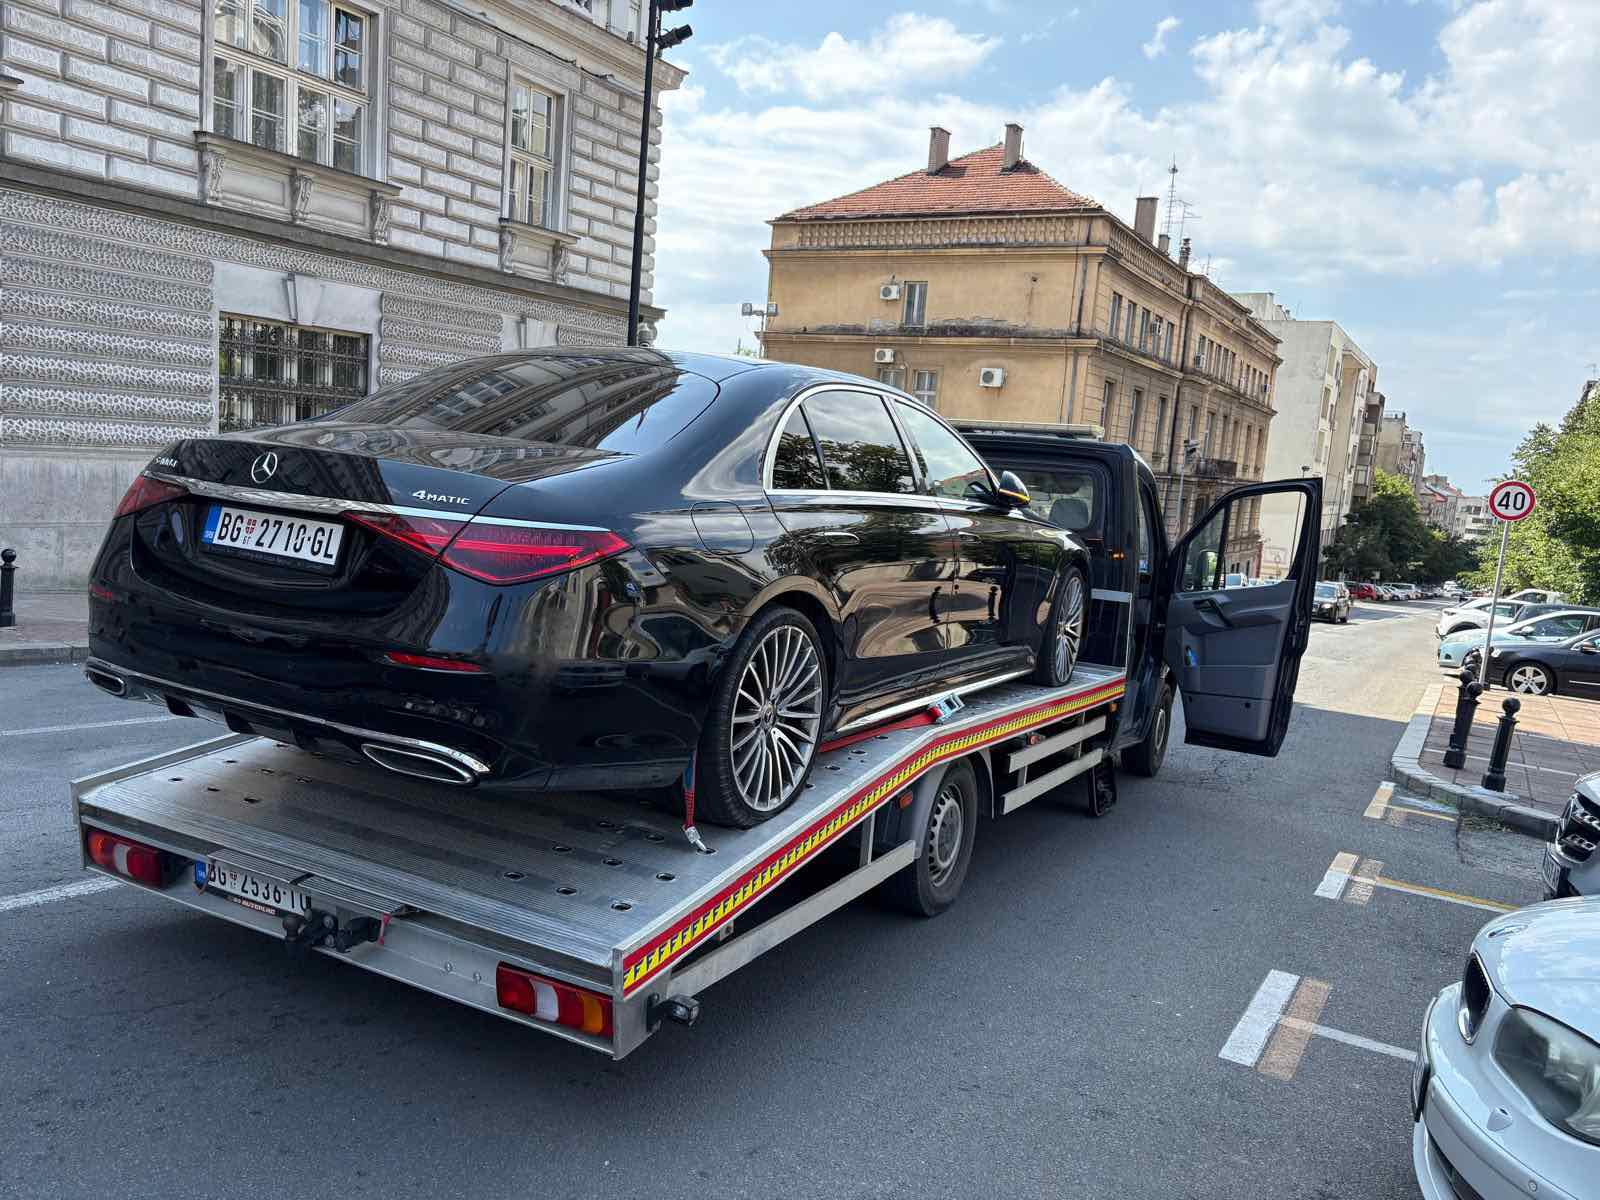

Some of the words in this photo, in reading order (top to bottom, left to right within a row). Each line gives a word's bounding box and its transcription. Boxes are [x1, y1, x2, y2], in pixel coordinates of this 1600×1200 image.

[412, 490, 470, 505] 4MATIC
[1497, 491, 1526, 511] 40
[217, 512, 244, 543] BG
